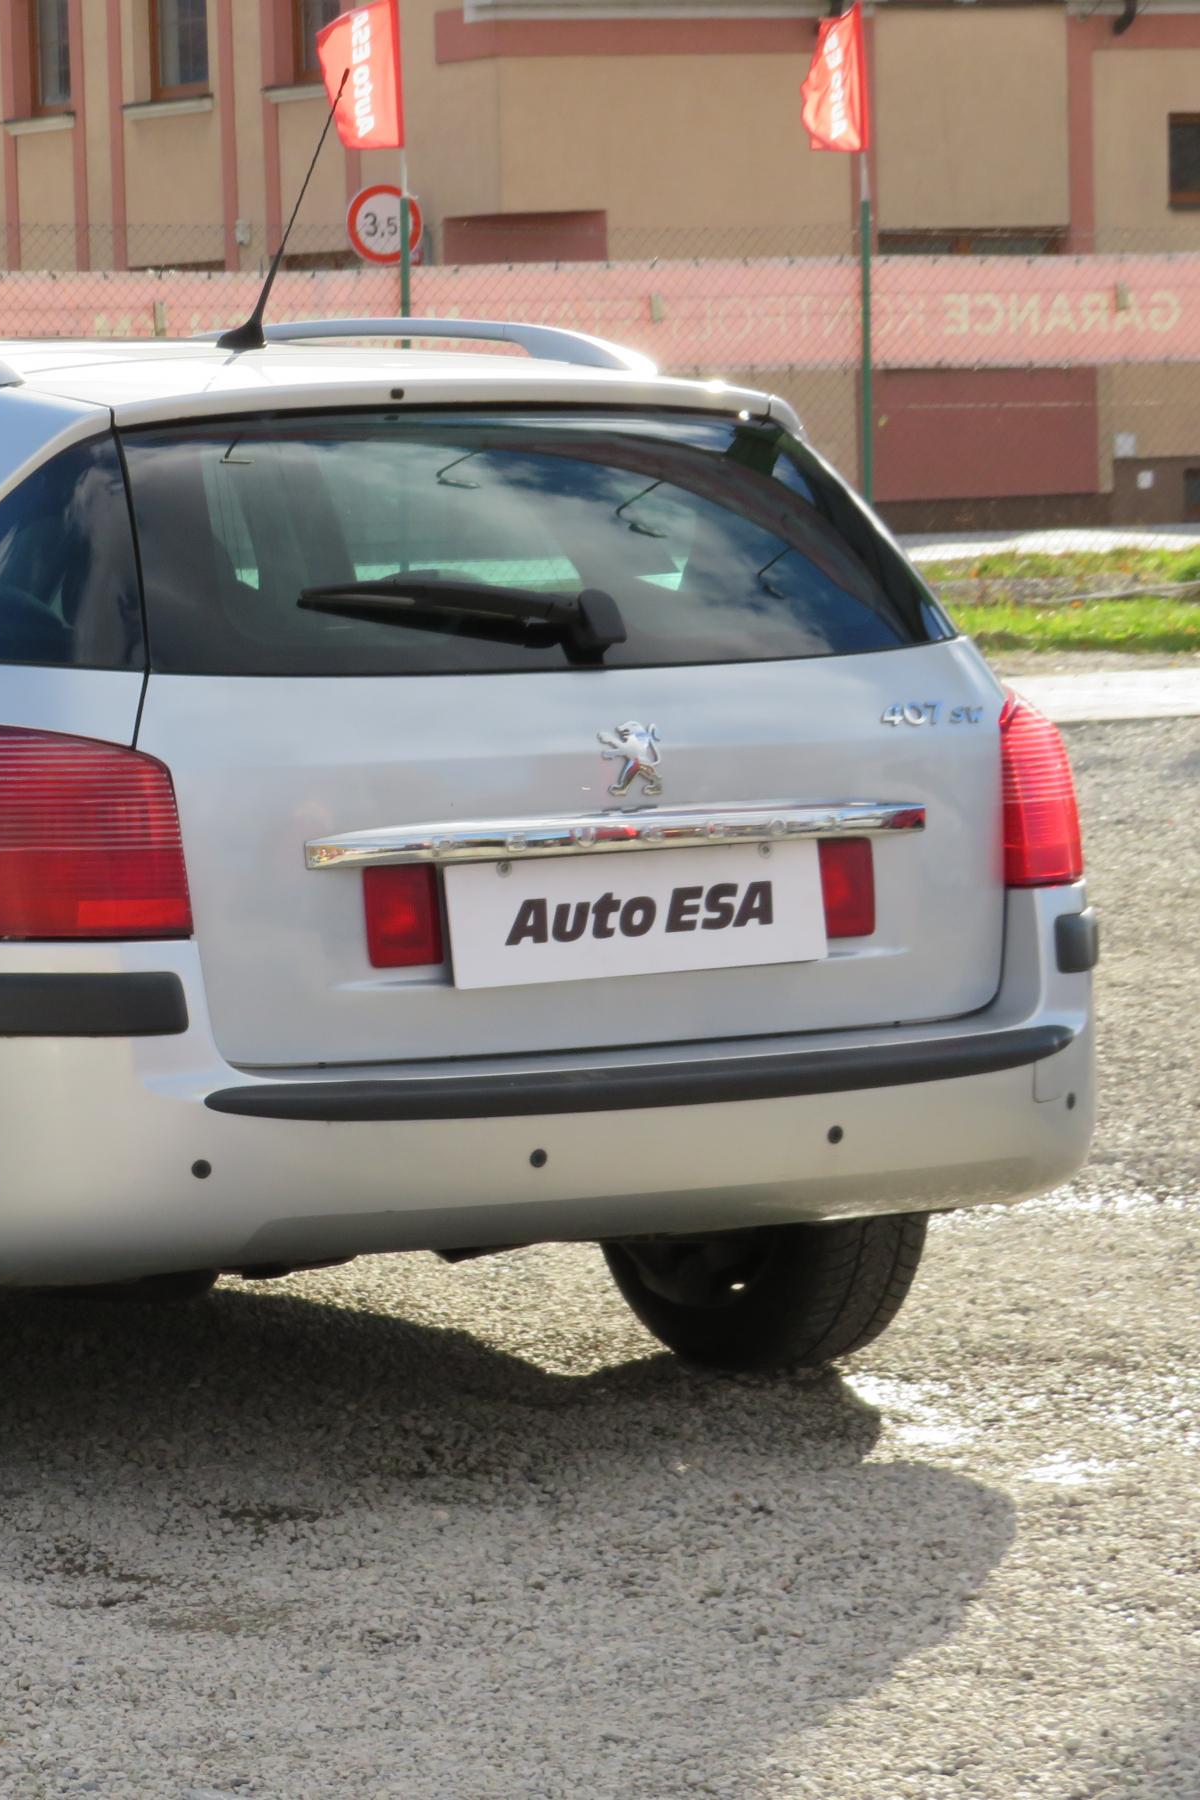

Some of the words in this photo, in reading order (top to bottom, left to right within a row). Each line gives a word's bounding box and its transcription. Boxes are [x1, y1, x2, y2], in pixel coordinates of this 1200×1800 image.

[364, 212, 398, 238] 3,5
[880, 701, 944, 727] 407
[505, 892, 656, 946] Auto
[665, 880, 774, 933] ESA
